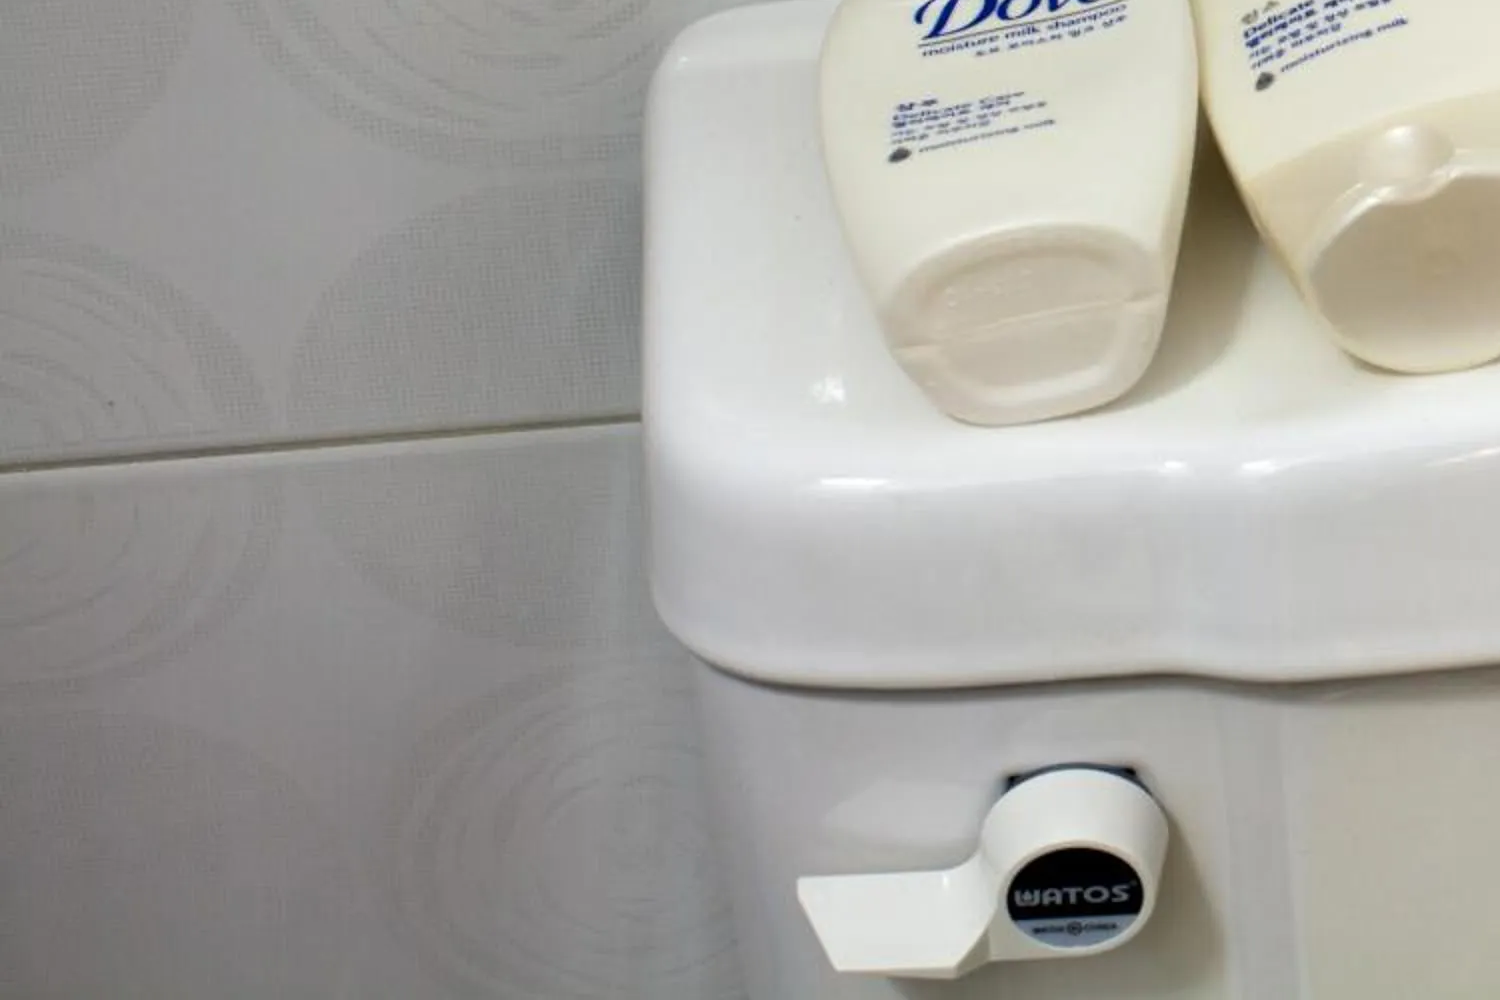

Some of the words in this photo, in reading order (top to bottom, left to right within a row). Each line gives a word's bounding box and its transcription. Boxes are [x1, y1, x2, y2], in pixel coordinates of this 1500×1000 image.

[1004, 24, 1041, 40] milk
[1047, 4, 1127, 30] shampoo
[1243, 0, 1315, 40] Delicate
[1013, 884, 1131, 907] WATOS
